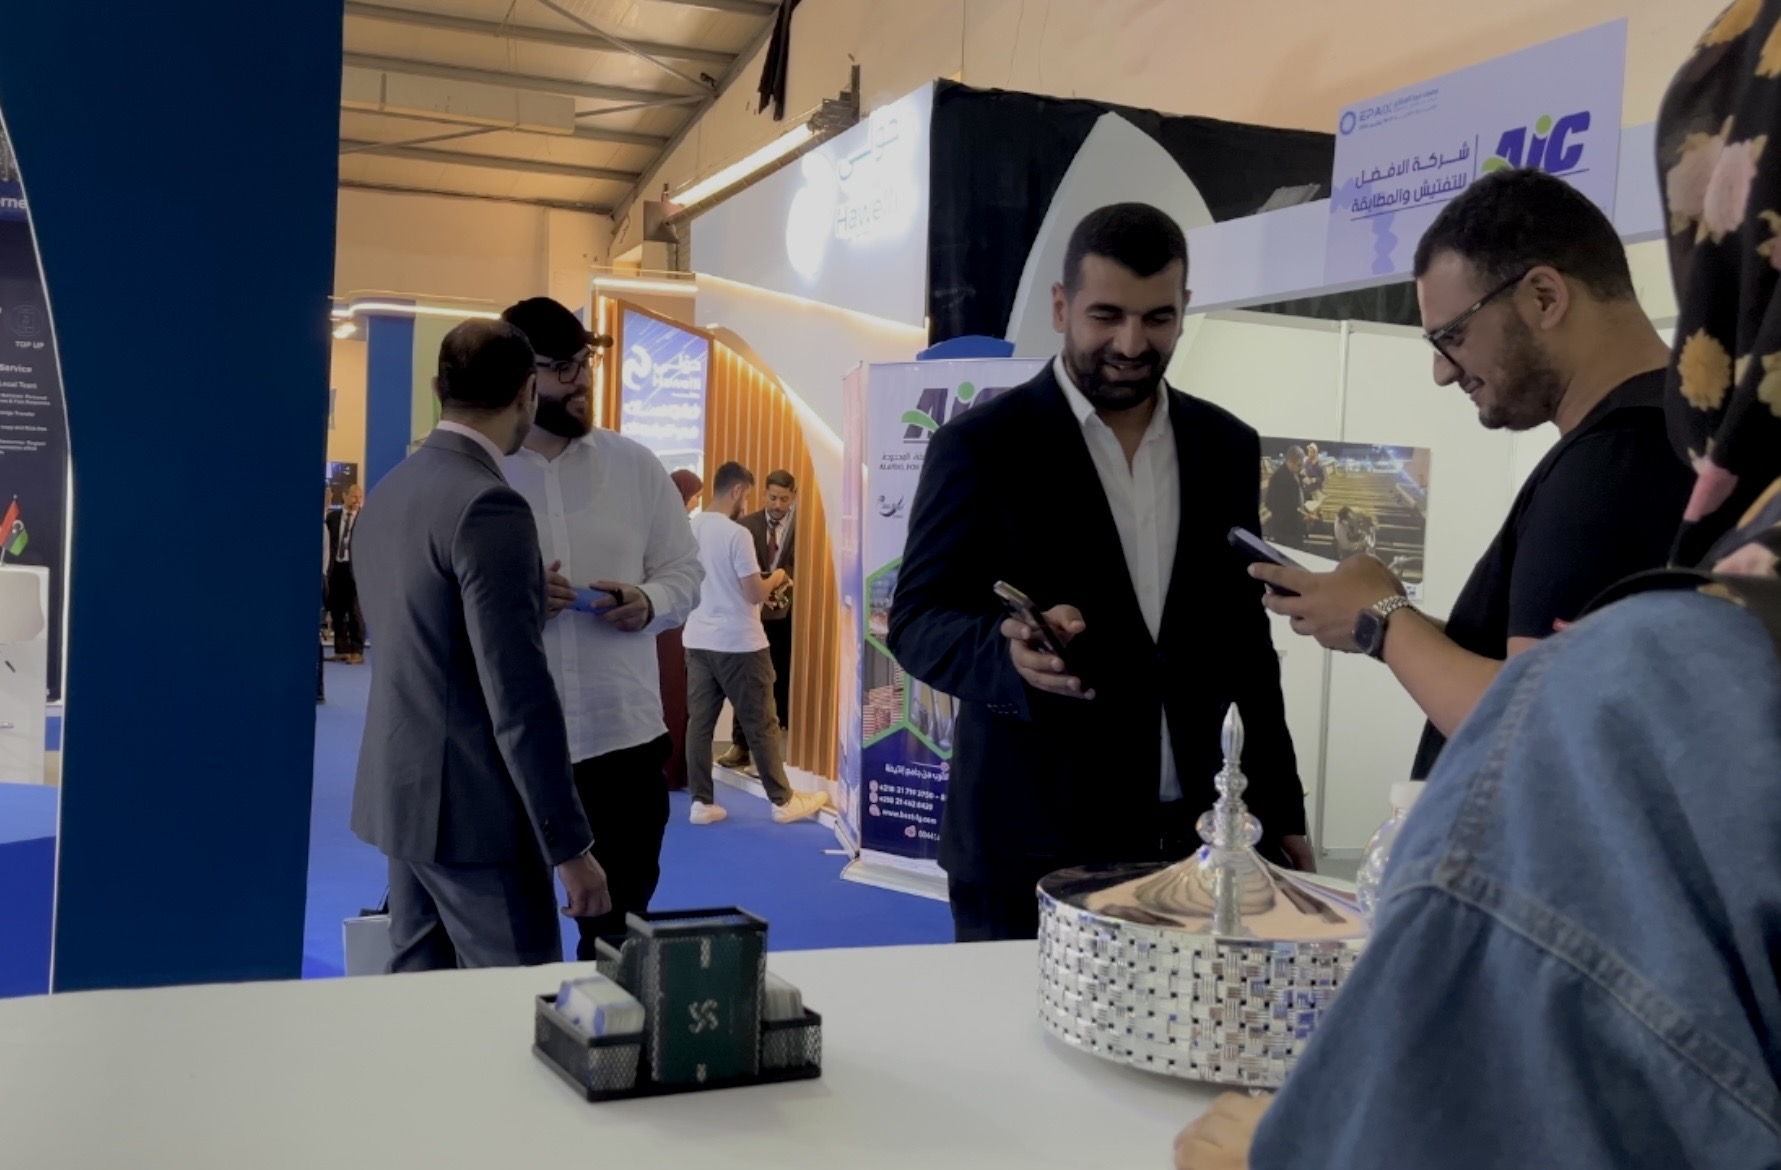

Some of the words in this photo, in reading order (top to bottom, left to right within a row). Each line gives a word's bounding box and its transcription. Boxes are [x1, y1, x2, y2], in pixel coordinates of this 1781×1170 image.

[1412, 142, 1470, 173] شركة
[1351, 189, 1411, 213] والمطابقة
[1413, 173, 1467, 203] للتفتيش
